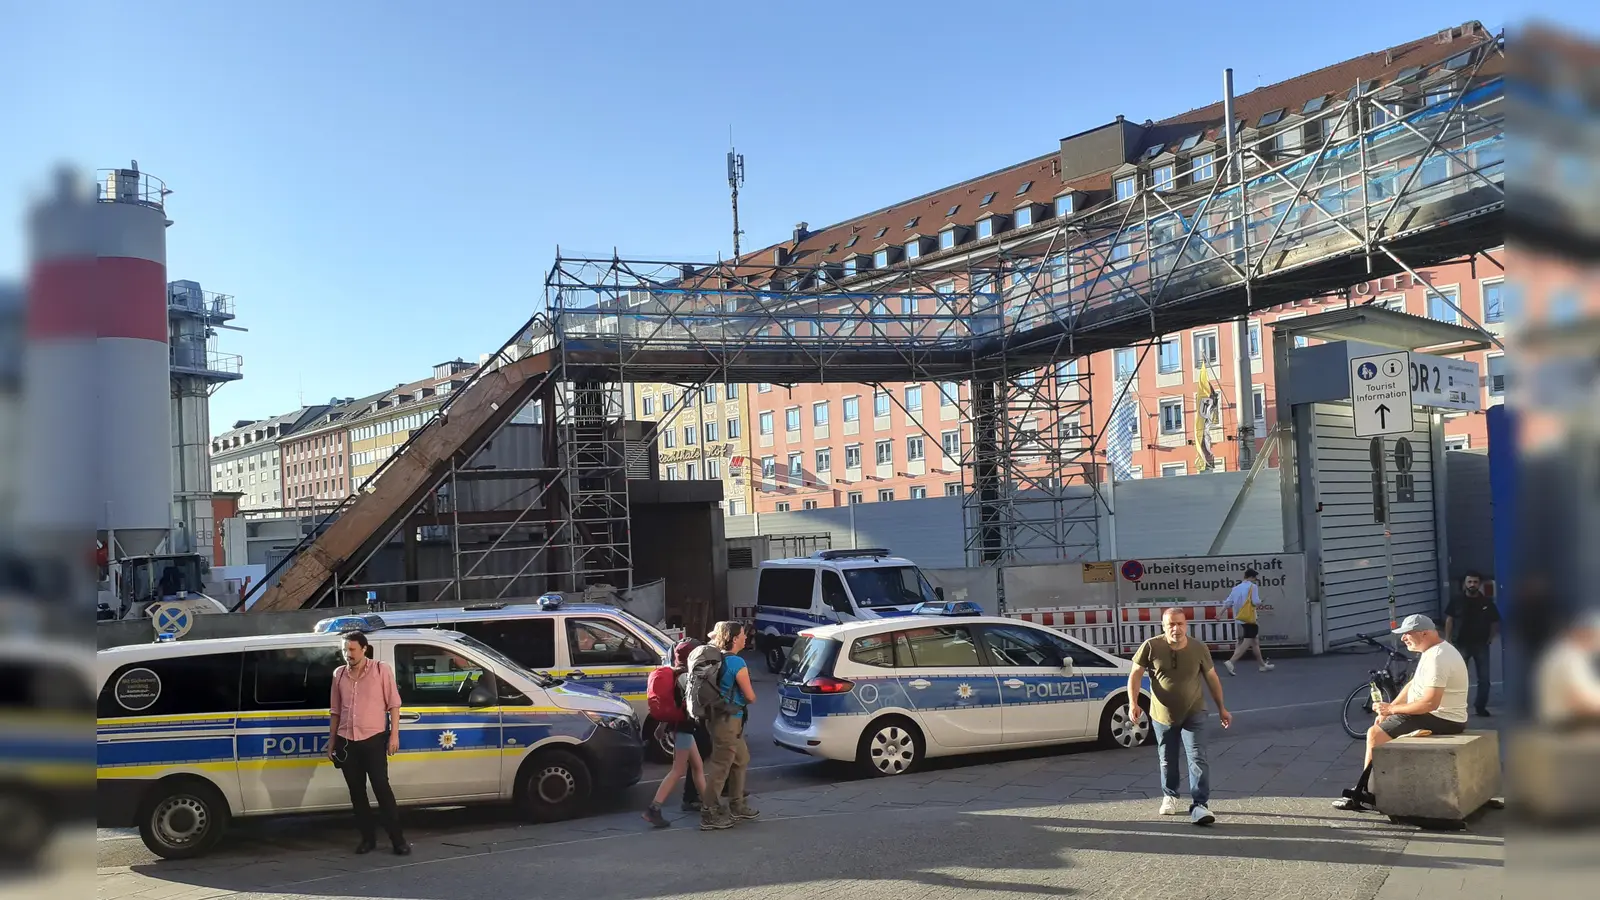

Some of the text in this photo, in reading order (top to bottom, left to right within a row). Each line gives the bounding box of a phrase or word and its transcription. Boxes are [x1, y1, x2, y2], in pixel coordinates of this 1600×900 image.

[1366, 381, 1396, 392] Tourist
[1432, 366, 1442, 394] 2
[1356, 390, 1407, 402] Information
[1133, 574, 1286, 592] Tunnel Hauptbahof
[1025, 681, 1085, 698] POLIZEI
[263, 735, 330, 754] POLIZ
